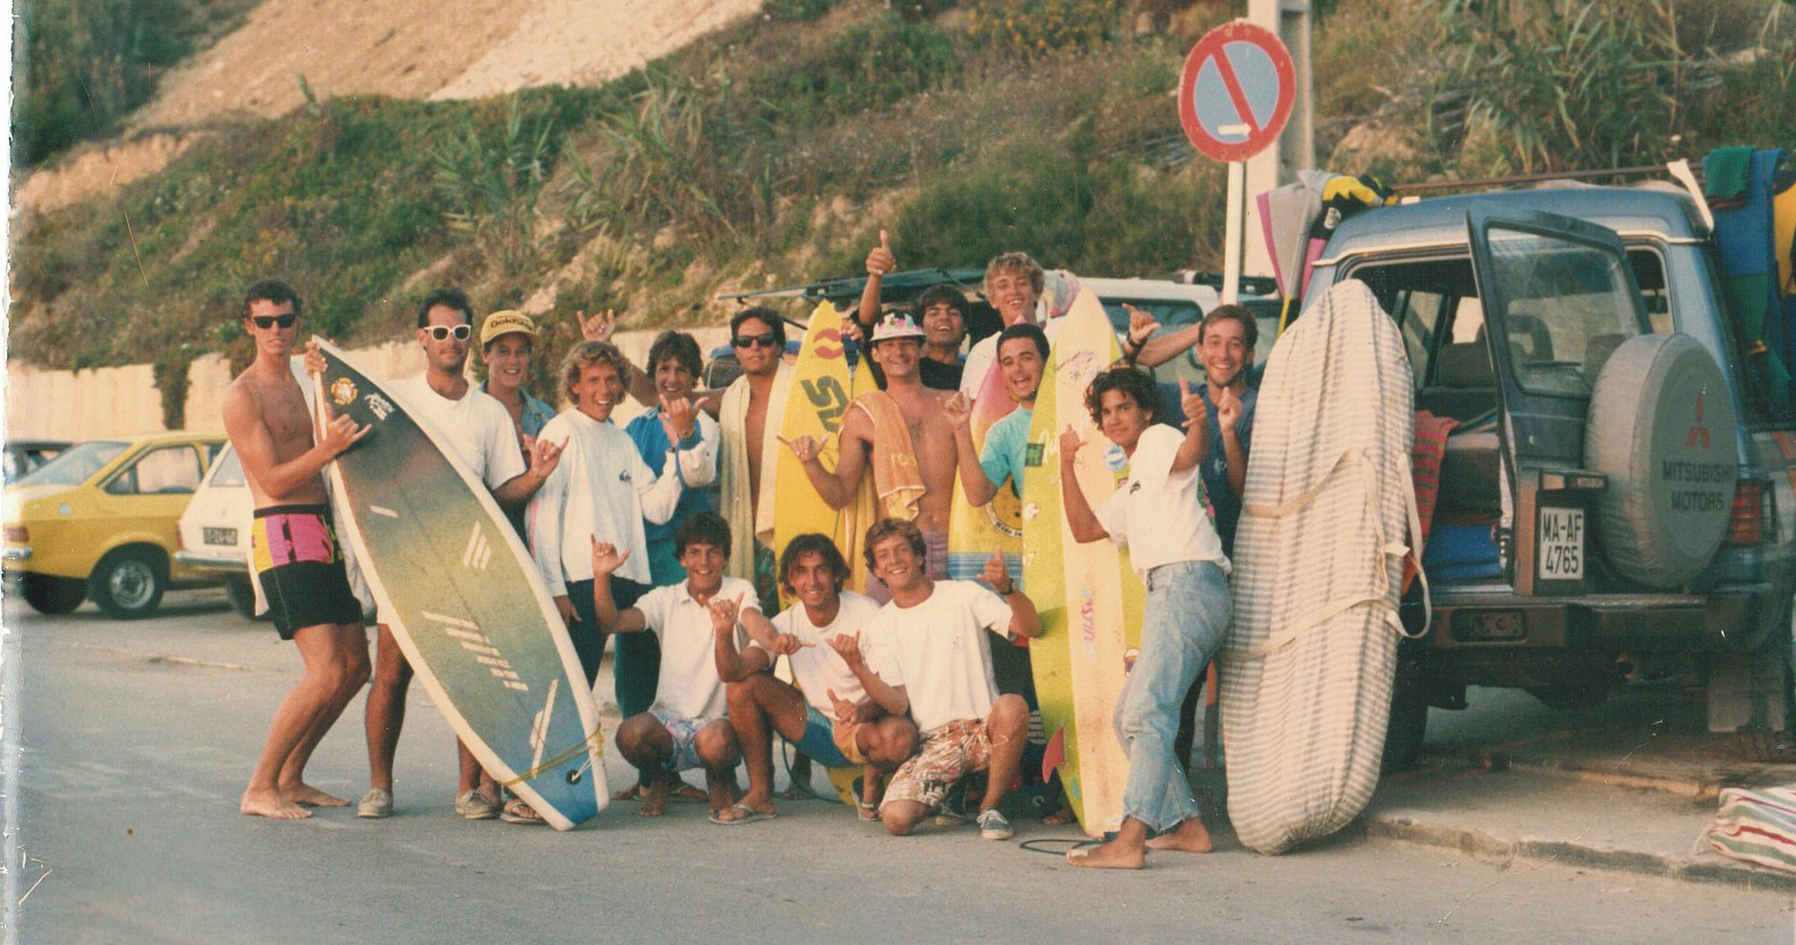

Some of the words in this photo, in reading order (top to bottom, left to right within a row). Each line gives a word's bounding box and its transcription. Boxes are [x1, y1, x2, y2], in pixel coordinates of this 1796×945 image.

[1662, 460, 1734, 483] MITSUBISHI
[1671, 490, 1724, 511] MOTORS
[1543, 513, 1582, 542] MA-AF
[1546, 545, 1579, 574] 4765
